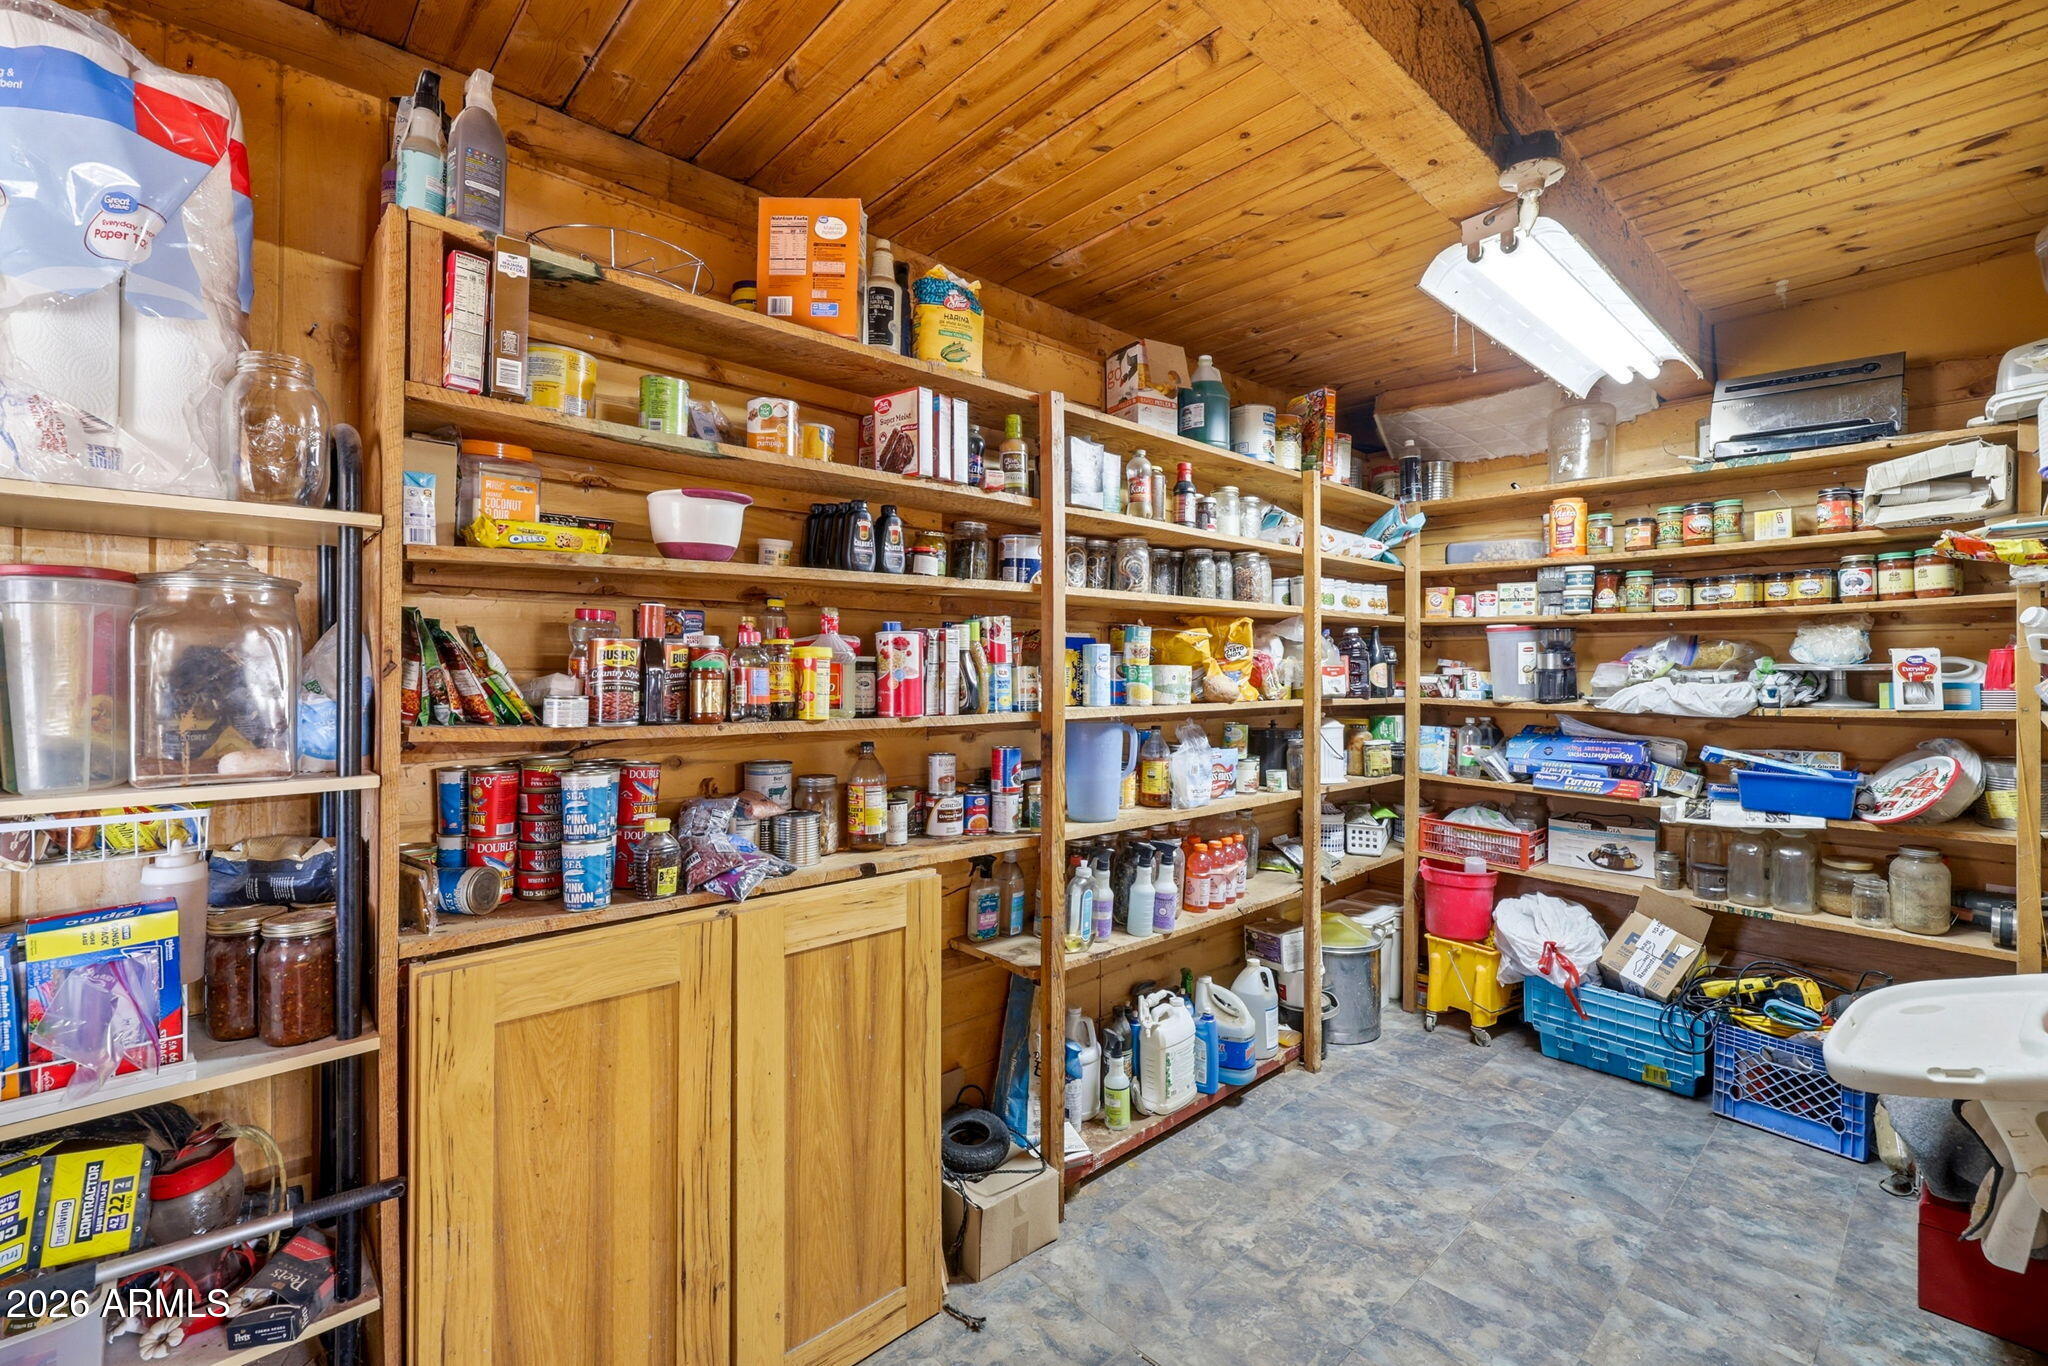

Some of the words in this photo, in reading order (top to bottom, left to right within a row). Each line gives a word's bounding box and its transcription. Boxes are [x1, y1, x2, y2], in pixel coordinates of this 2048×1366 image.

[102, 219, 138, 231] Everyday
[94, 228, 129, 240] Paper
[485, 497, 522, 511] COCONUT
[566, 814, 588, 825] PINK
[535, 833, 560, 843] SALMO
[535, 861, 560, 871] SALMO
[565, 882, 585, 893] PINK
[79, 1164, 101, 1239] CONTRACTOR
[109, 1194, 126, 1215] 22
[55, 1201, 73, 1245] trueliving
[109, 1217, 120, 1229] 42
[270, 1267, 309, 1292] Peet's
